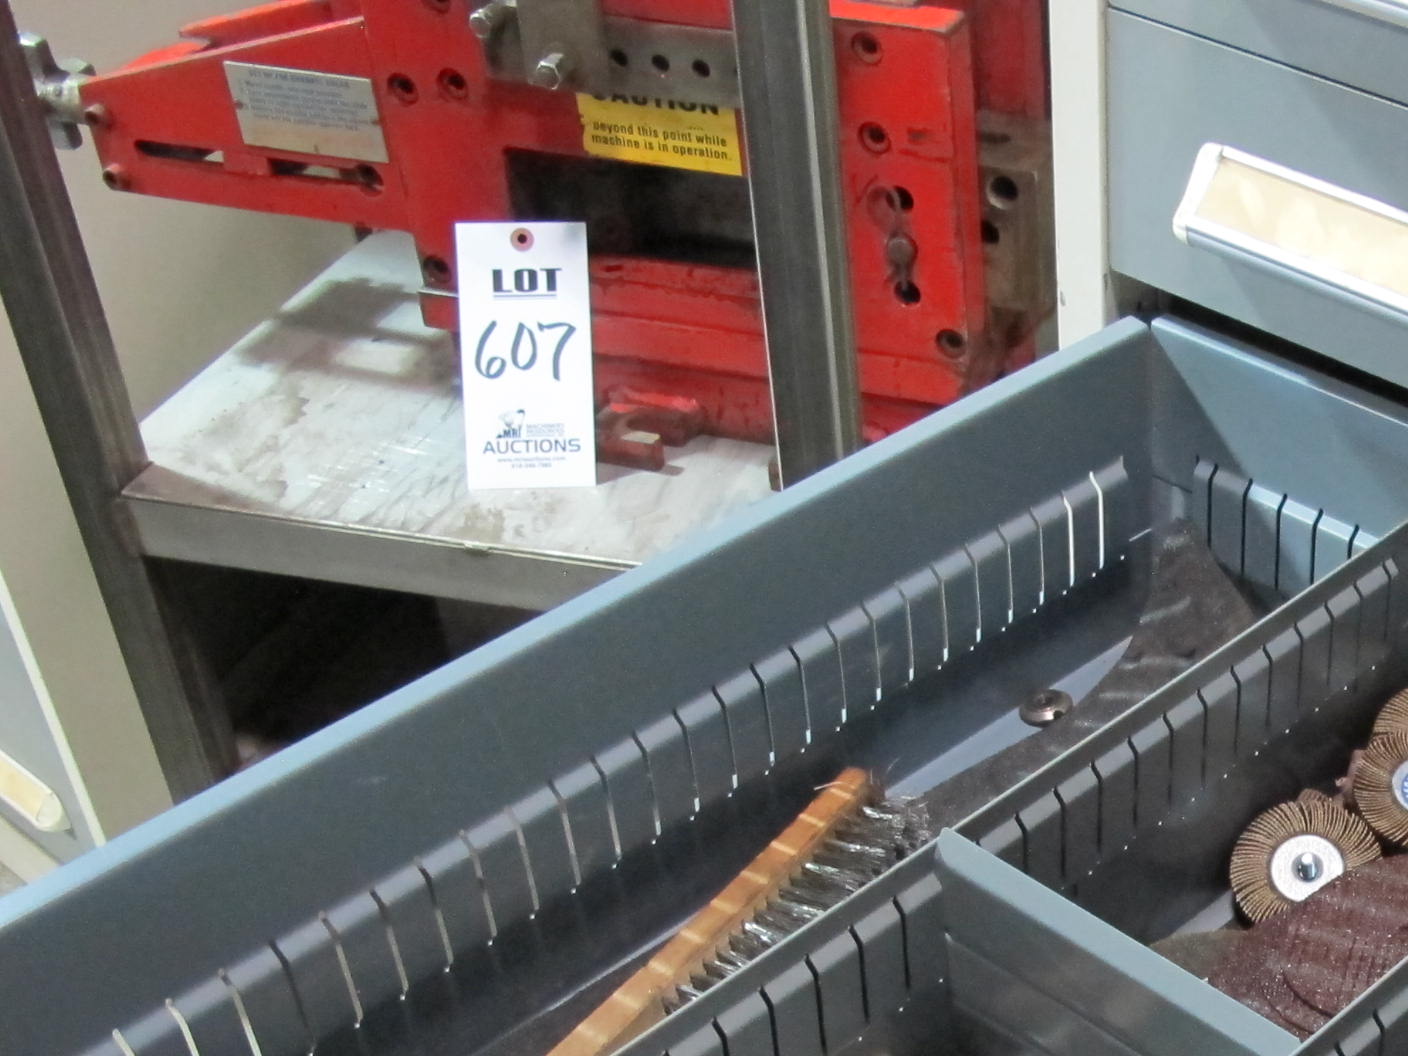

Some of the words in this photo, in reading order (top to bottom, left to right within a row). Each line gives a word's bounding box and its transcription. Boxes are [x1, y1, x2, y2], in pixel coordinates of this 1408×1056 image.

[592, 134, 640, 149] machine
[644, 139, 654, 151] is
[658, 141, 669, 153] in
[637, 125, 659, 138] this
[662, 129, 693, 143] point
[695, 133, 728, 147] while
[491, 267, 562, 293] LOT
[474, 320, 577, 381] 607
[482, 438, 581, 455] AUCTIONS
